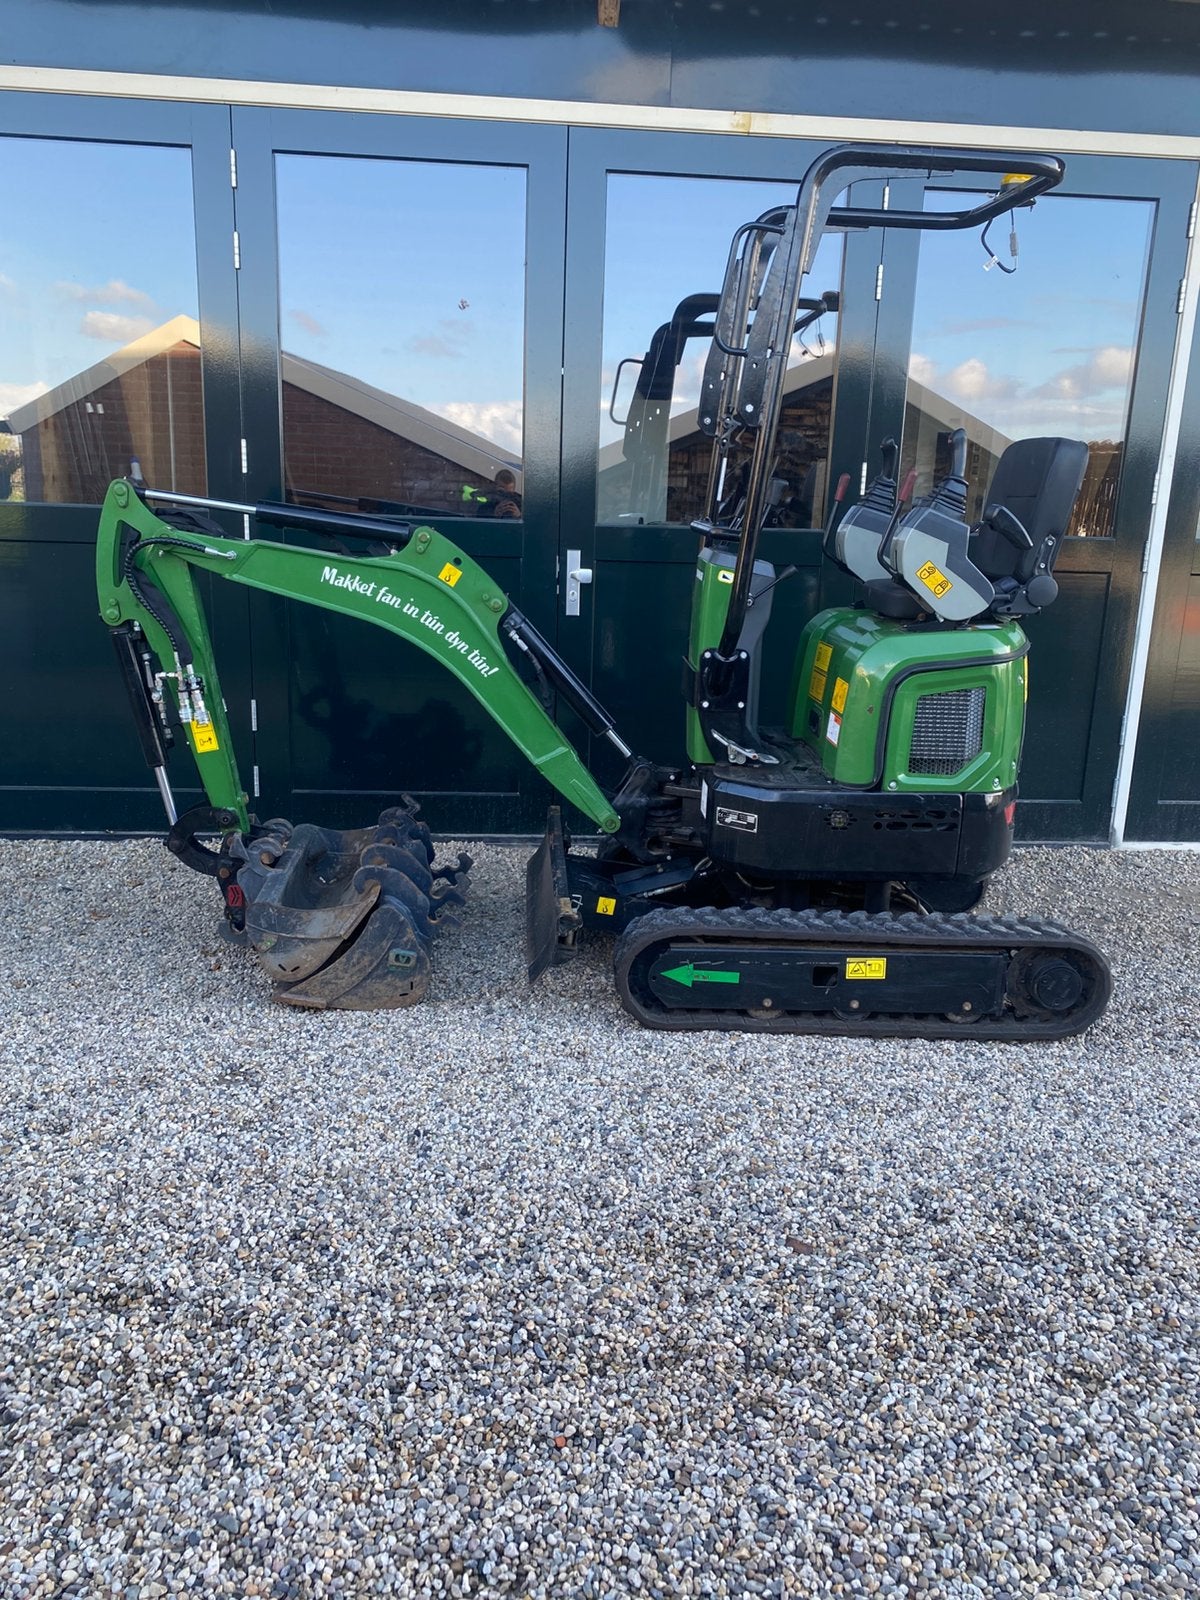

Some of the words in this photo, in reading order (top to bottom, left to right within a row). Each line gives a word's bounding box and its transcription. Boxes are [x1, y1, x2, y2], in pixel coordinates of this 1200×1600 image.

[320, 565, 378, 597] Makket
[375, 586, 402, 609] fan
[402, 598, 420, 618] in
[420, 610, 444, 635] tún
[445, 631, 469, 655] dyn
[467, 649, 500, 678] tún!
